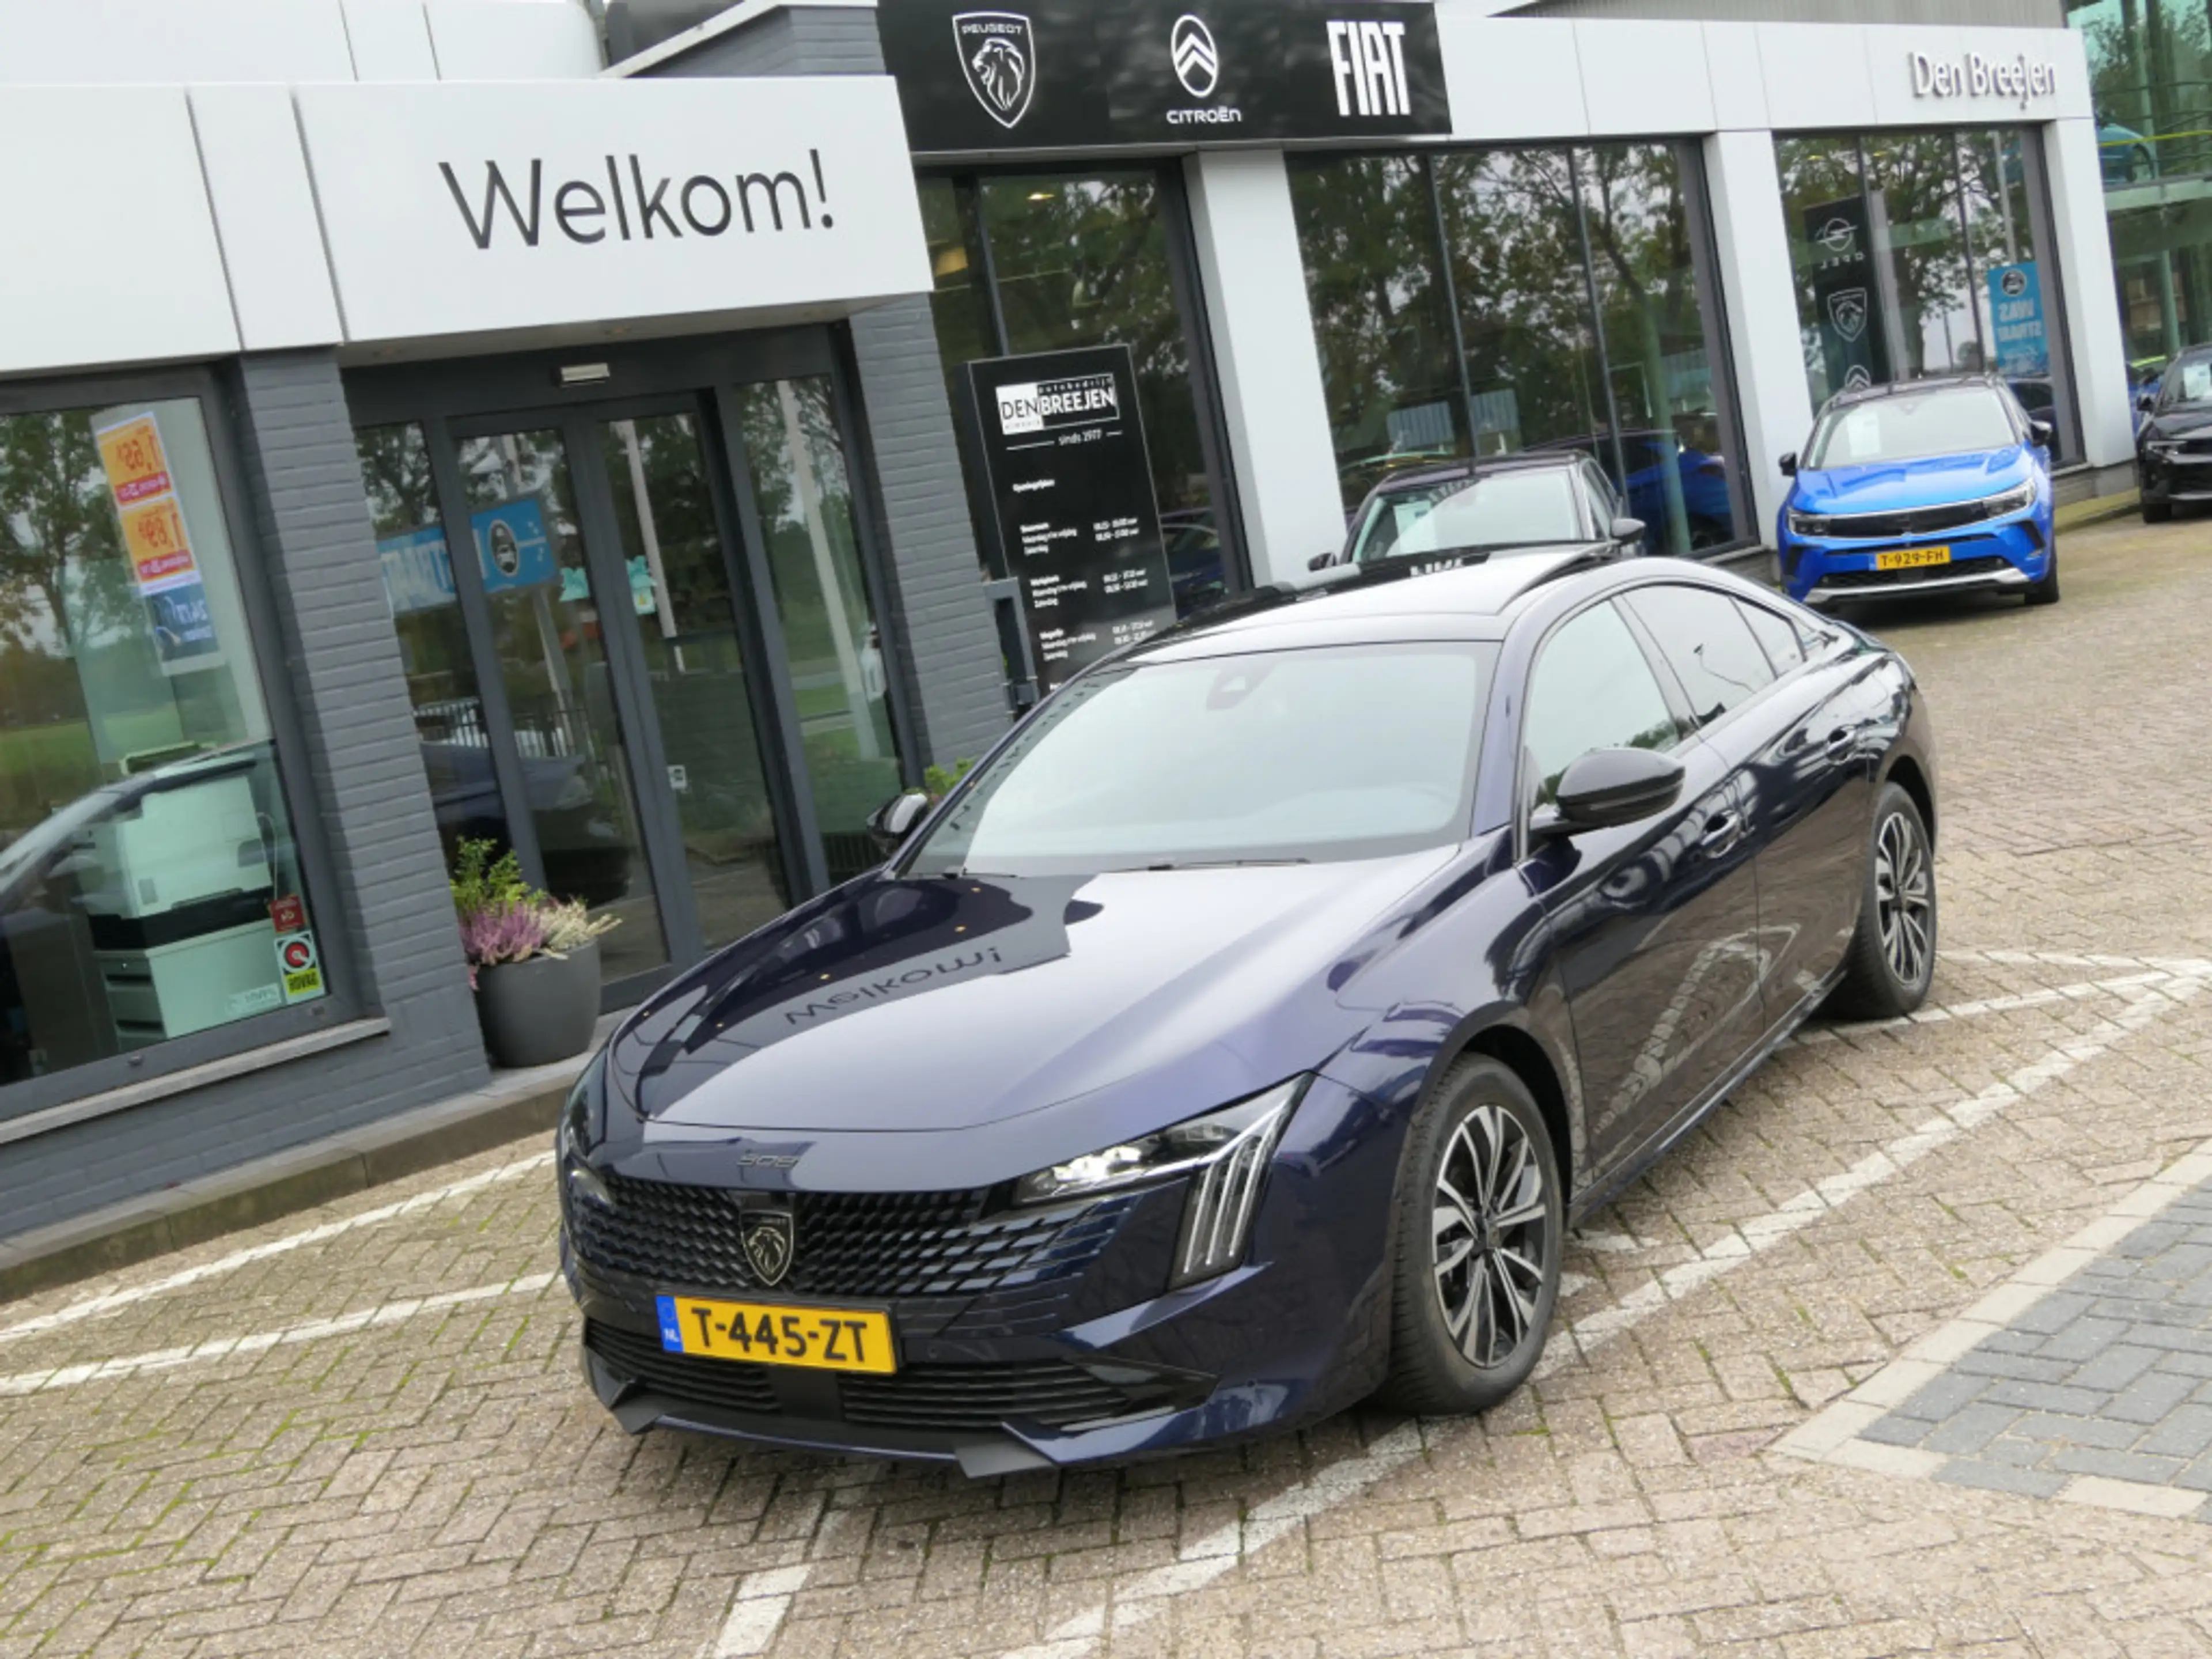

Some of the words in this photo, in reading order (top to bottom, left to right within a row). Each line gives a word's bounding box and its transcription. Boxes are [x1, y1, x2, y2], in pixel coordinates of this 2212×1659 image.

[961, 23, 1023, 35] PEUGEOT
[1325, 21, 1411, 116] FIAT
[1908, 51, 1963, 98] Den
[437, 148, 834, 249] Welkom!
[1001, 396, 1040, 420] DEN
[1040, 386, 1115, 416] BREEJEN
[1881, 549, 1945, 567] T-929-FH
[664, 1327, 680, 1343] NL
[691, 1306, 868, 1362] T-445-ZT
